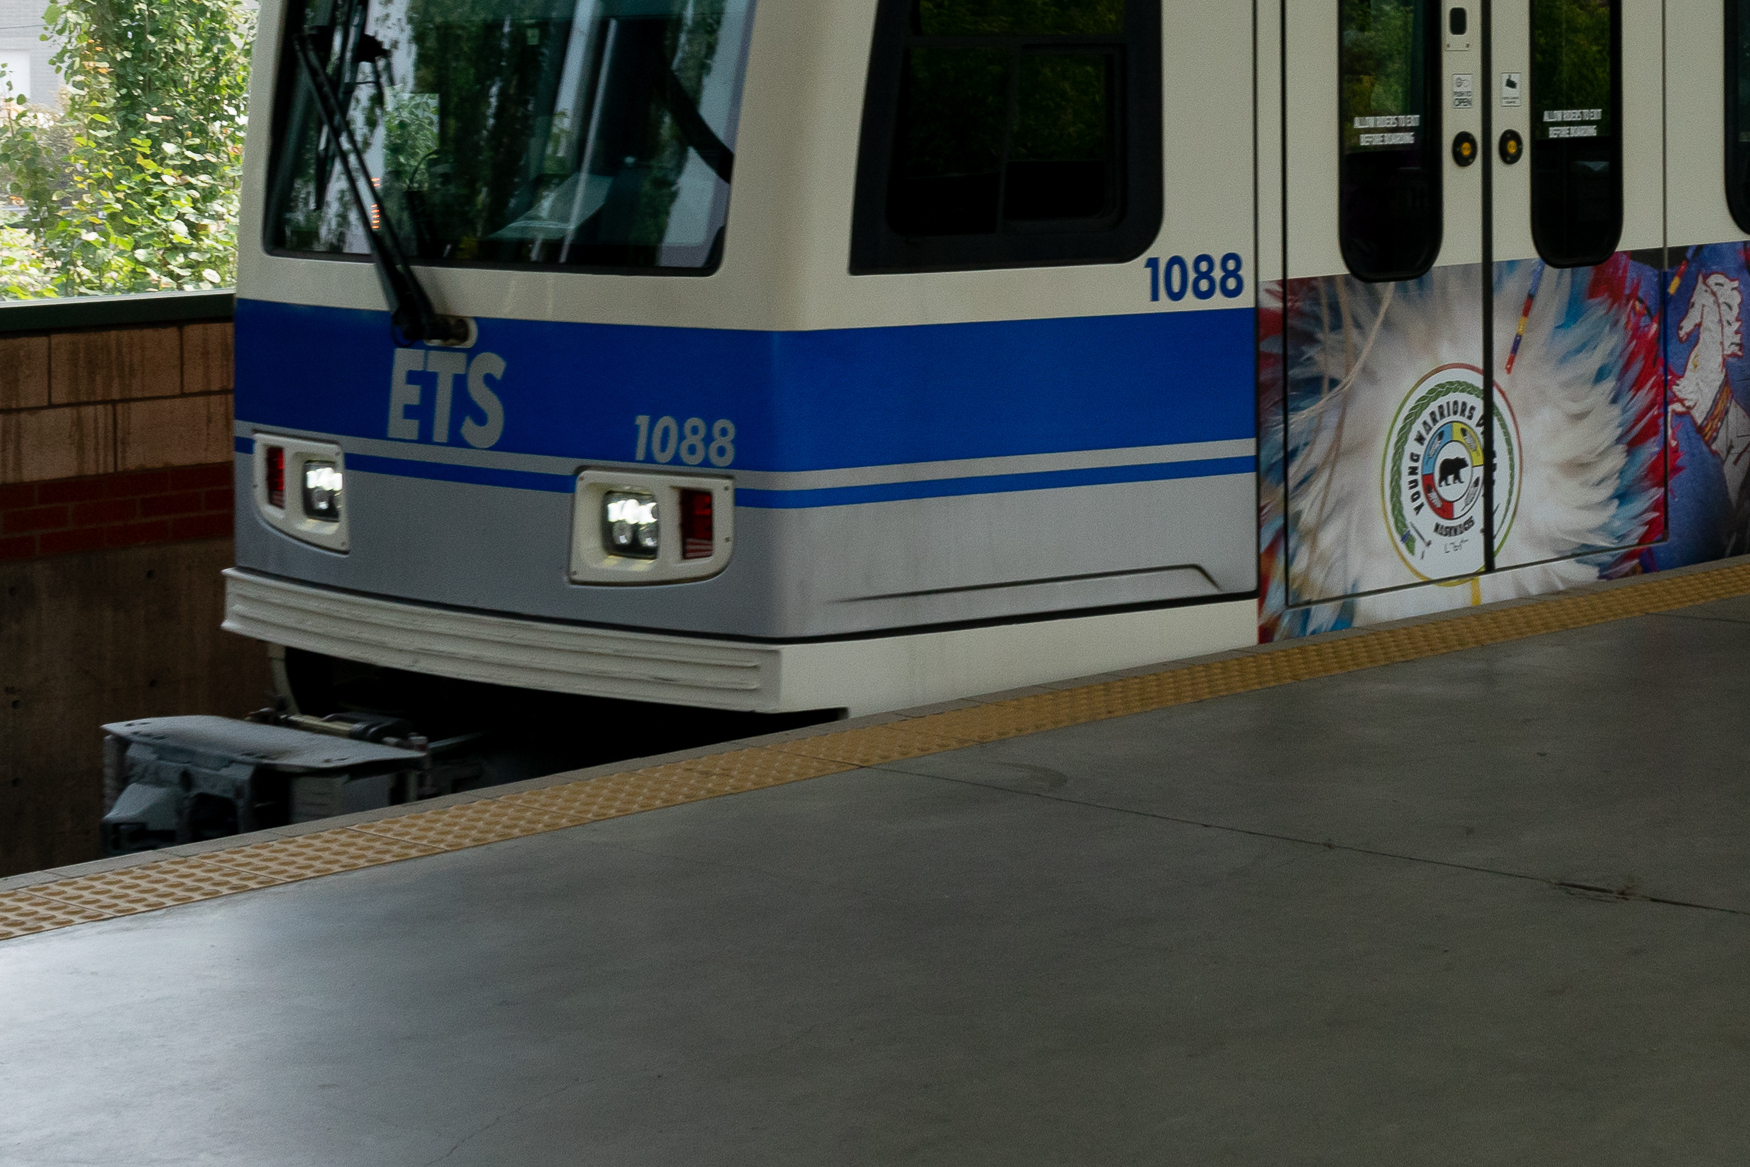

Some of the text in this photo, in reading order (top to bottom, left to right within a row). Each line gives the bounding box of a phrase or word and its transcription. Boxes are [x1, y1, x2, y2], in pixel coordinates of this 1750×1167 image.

[1144, 252, 1244, 302] 1088
[387, 347, 507, 449] ETS
[635, 414, 736, 468] 1088
[1407, 400, 1476, 516] YOUNG WARRIORS
